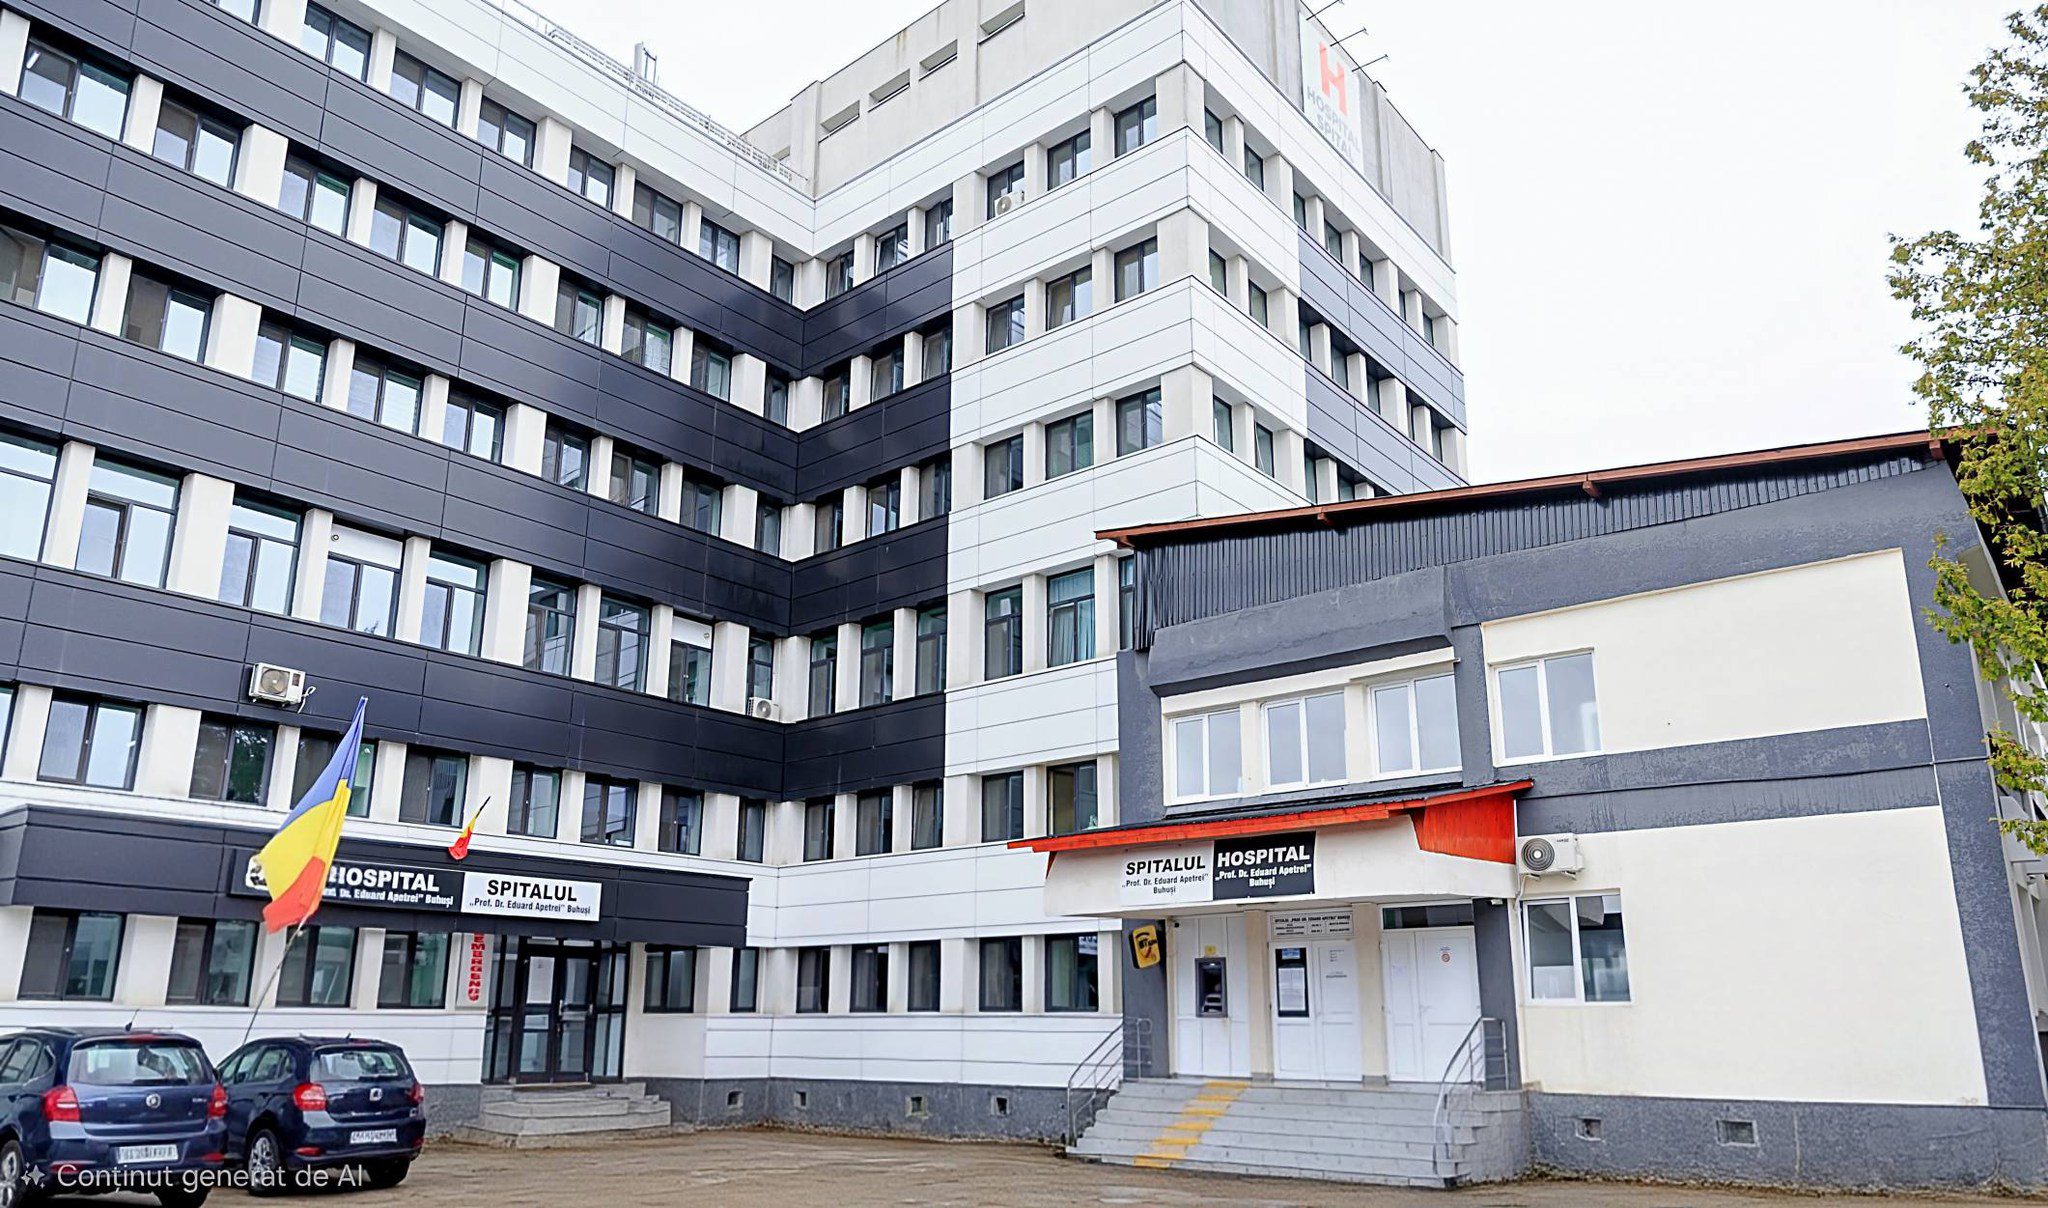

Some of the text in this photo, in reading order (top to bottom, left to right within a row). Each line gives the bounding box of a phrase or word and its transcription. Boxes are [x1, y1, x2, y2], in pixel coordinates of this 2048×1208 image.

[1307, 86, 1360, 152] HOSPITAL
[1126, 855, 1206, 875] SPITALUL
[1217, 845, 1310, 867] HOSPITAL
[328, 866, 440, 892] HOSPITAL
[1143, 878, 1152, 886] Dr.
[1154, 876, 1177, 885] Eduard
[1238, 869, 1249, 878] Dr.
[1250, 867, 1277, 877] Eduard
[354, 890, 386, 901] Eduard
[487, 879, 577, 902] SPITALUL
[495, 899, 505, 908] Dr.
[507, 900, 533, 910] Eduard
